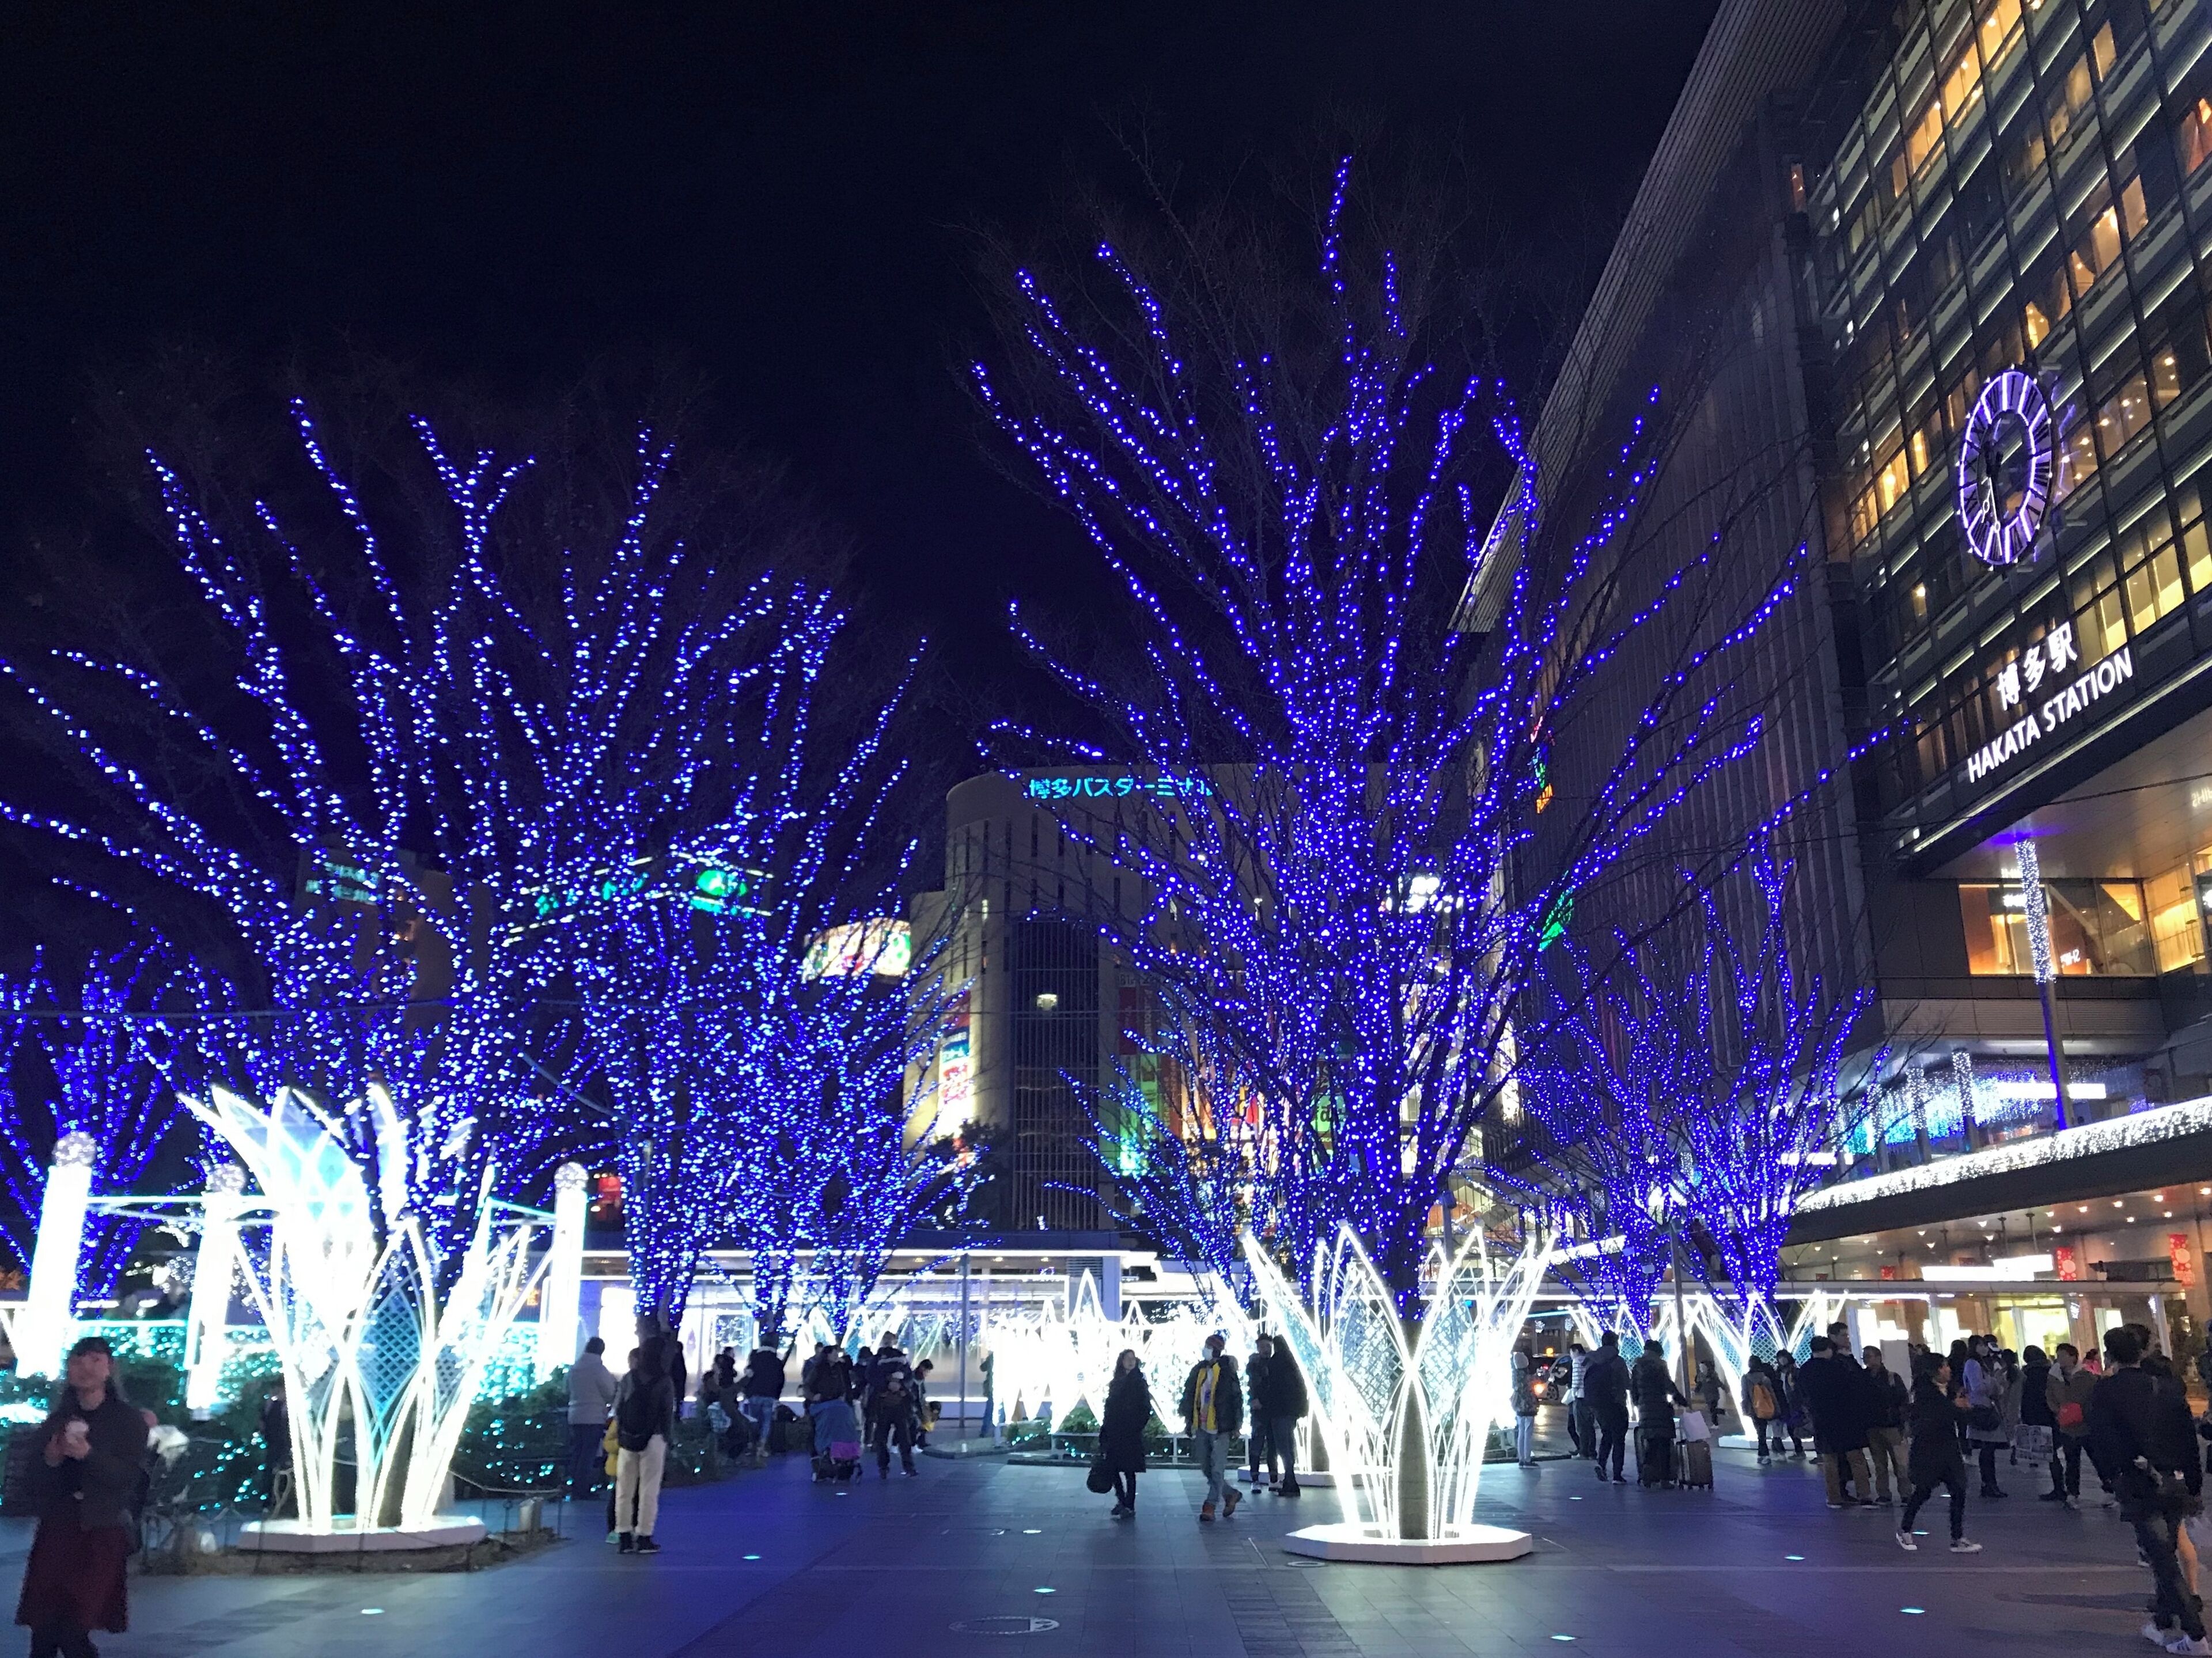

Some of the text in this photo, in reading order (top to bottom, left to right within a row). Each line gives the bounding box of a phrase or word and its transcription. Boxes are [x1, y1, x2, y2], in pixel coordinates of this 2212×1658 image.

[1967, 646, 2133, 784] HAKATA STATION
[1997, 621, 2078, 711] 博多駅
